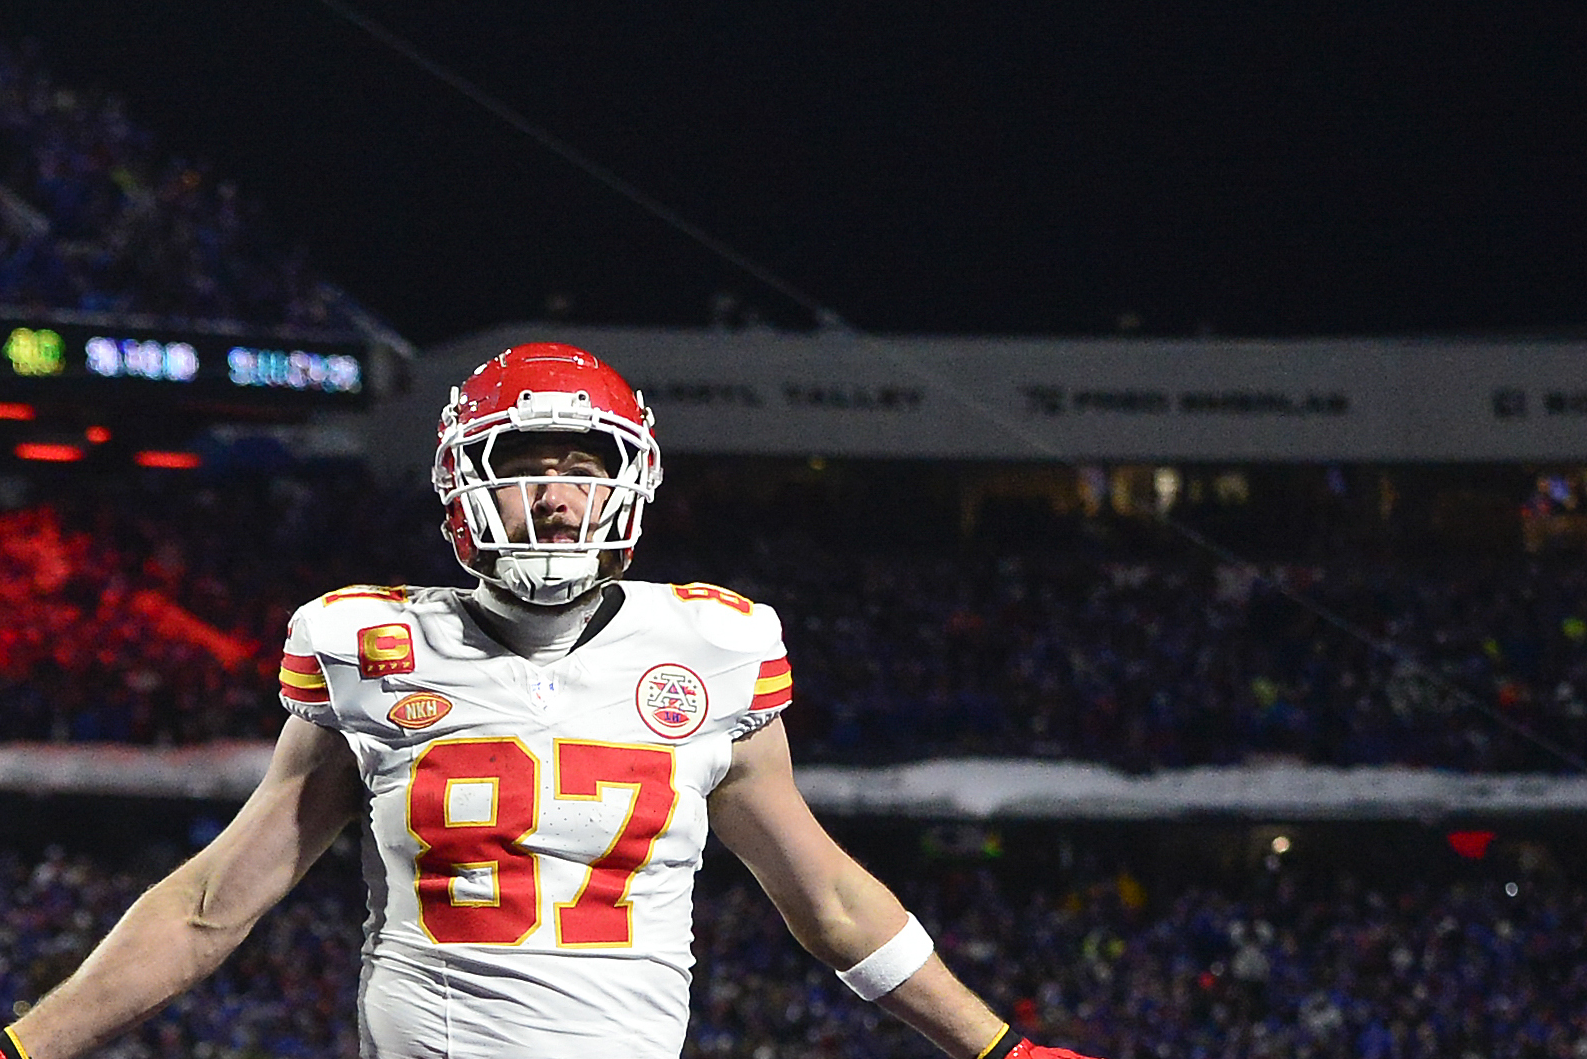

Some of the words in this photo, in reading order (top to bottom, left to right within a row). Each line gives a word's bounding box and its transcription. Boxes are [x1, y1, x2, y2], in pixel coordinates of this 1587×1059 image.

[365, 625, 409, 662] C
[405, 700, 437, 719] NKH
[407, 736, 679, 948] 87
